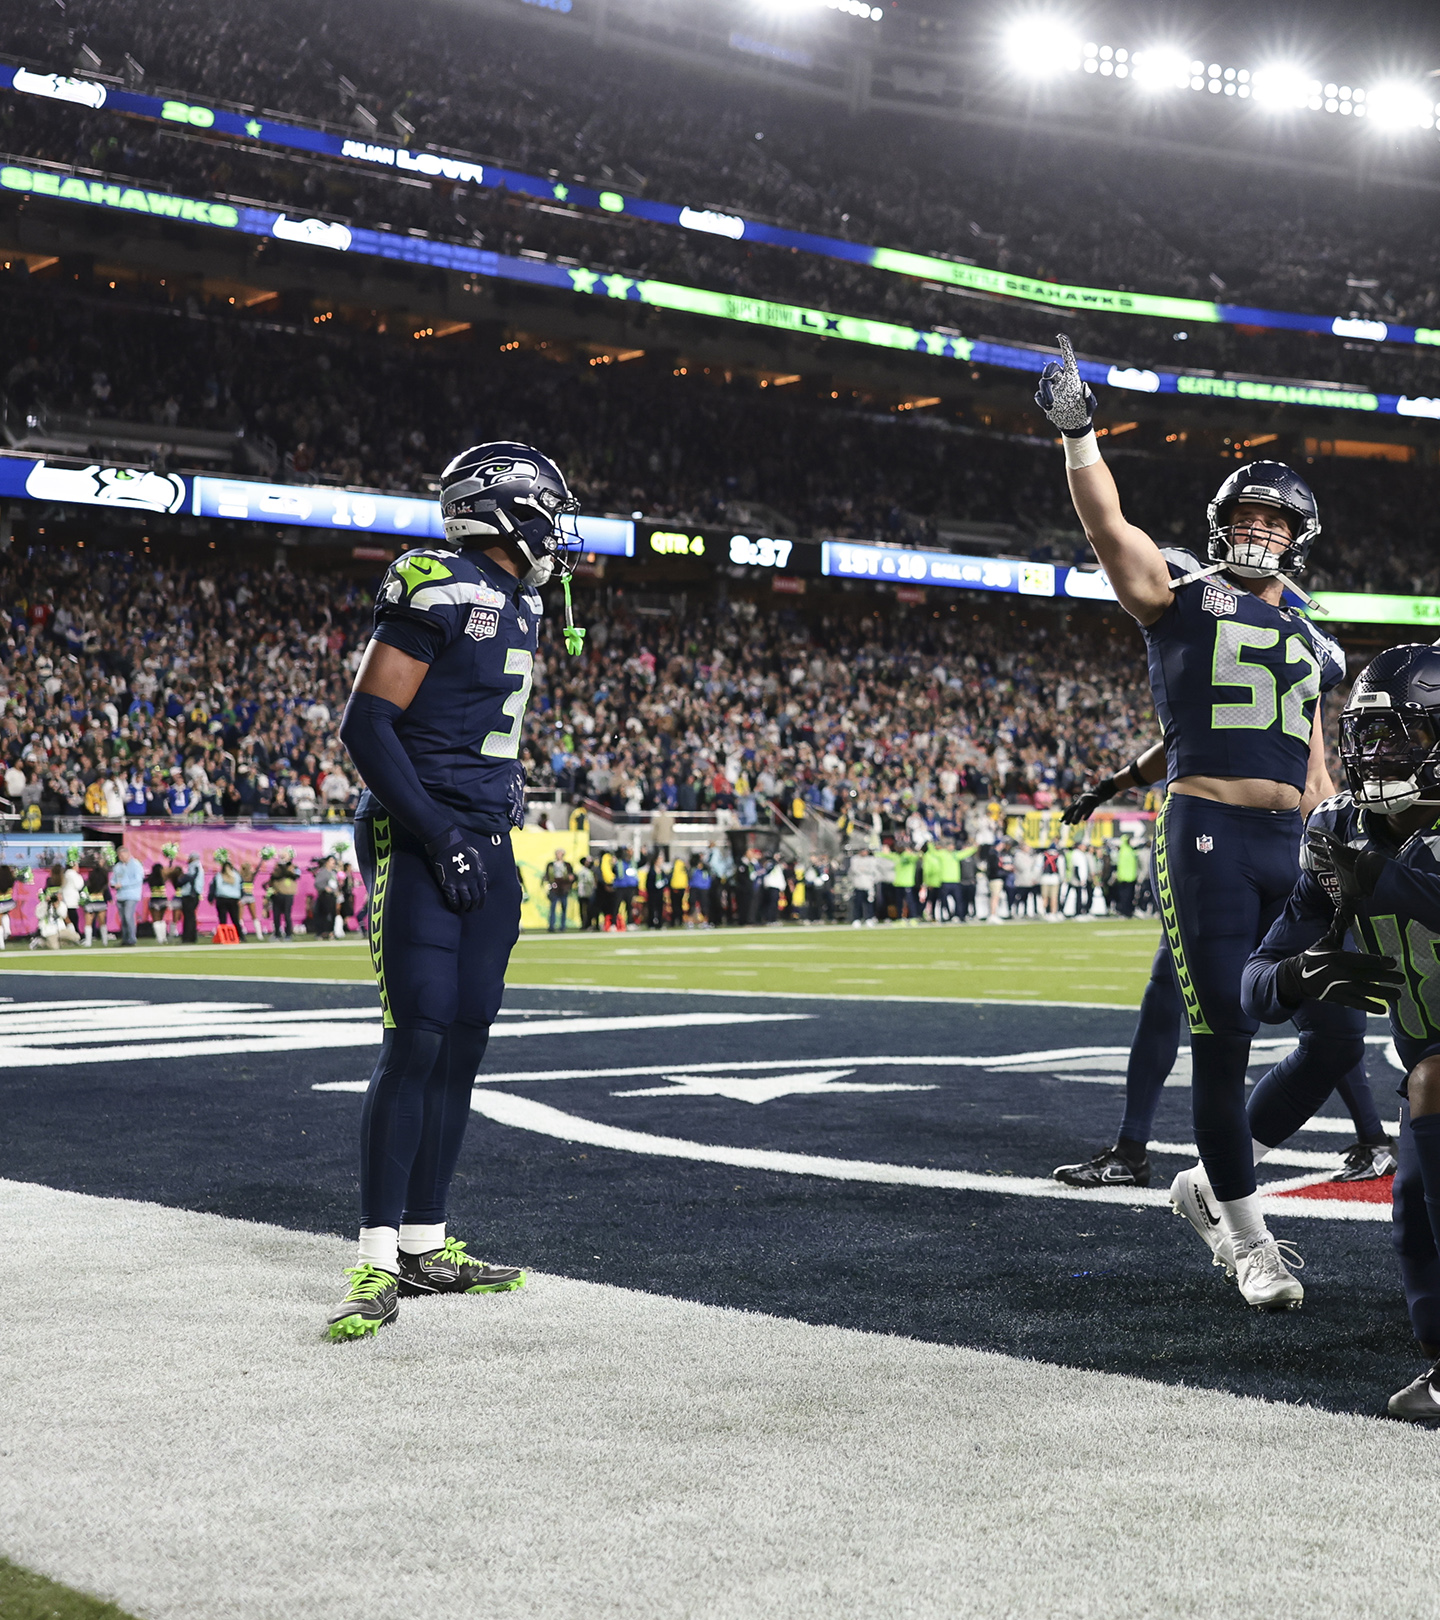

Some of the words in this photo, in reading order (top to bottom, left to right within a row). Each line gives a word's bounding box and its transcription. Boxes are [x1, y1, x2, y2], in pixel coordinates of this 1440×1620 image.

[161, 101, 215, 127] 20
[0, 166, 239, 227] SEAHAWKS
[1006, 280, 1133, 307] SEAHAWKS
[1177, 376, 1237, 398] SEATTLE
[1237, 381, 1379, 411] SEAHAWKS
[332, 496, 376, 527] 19
[650, 531, 690, 555] QTR
[689, 535, 705, 556] 4
[729, 535, 793, 568] 8:37
[839, 550, 882, 575] 1ST
[898, 554, 928, 580] 10
[1204, 600, 1235, 613] 250
[1207, 589, 1234, 602] USA
[468, 623, 495, 635] 250
[473, 611, 495, 622] USA
[1211, 620, 1321, 746] 52
[480, 648, 534, 760] 3
[1321, 877, 1338, 887] US
[221, 928, 236, 943] 10
